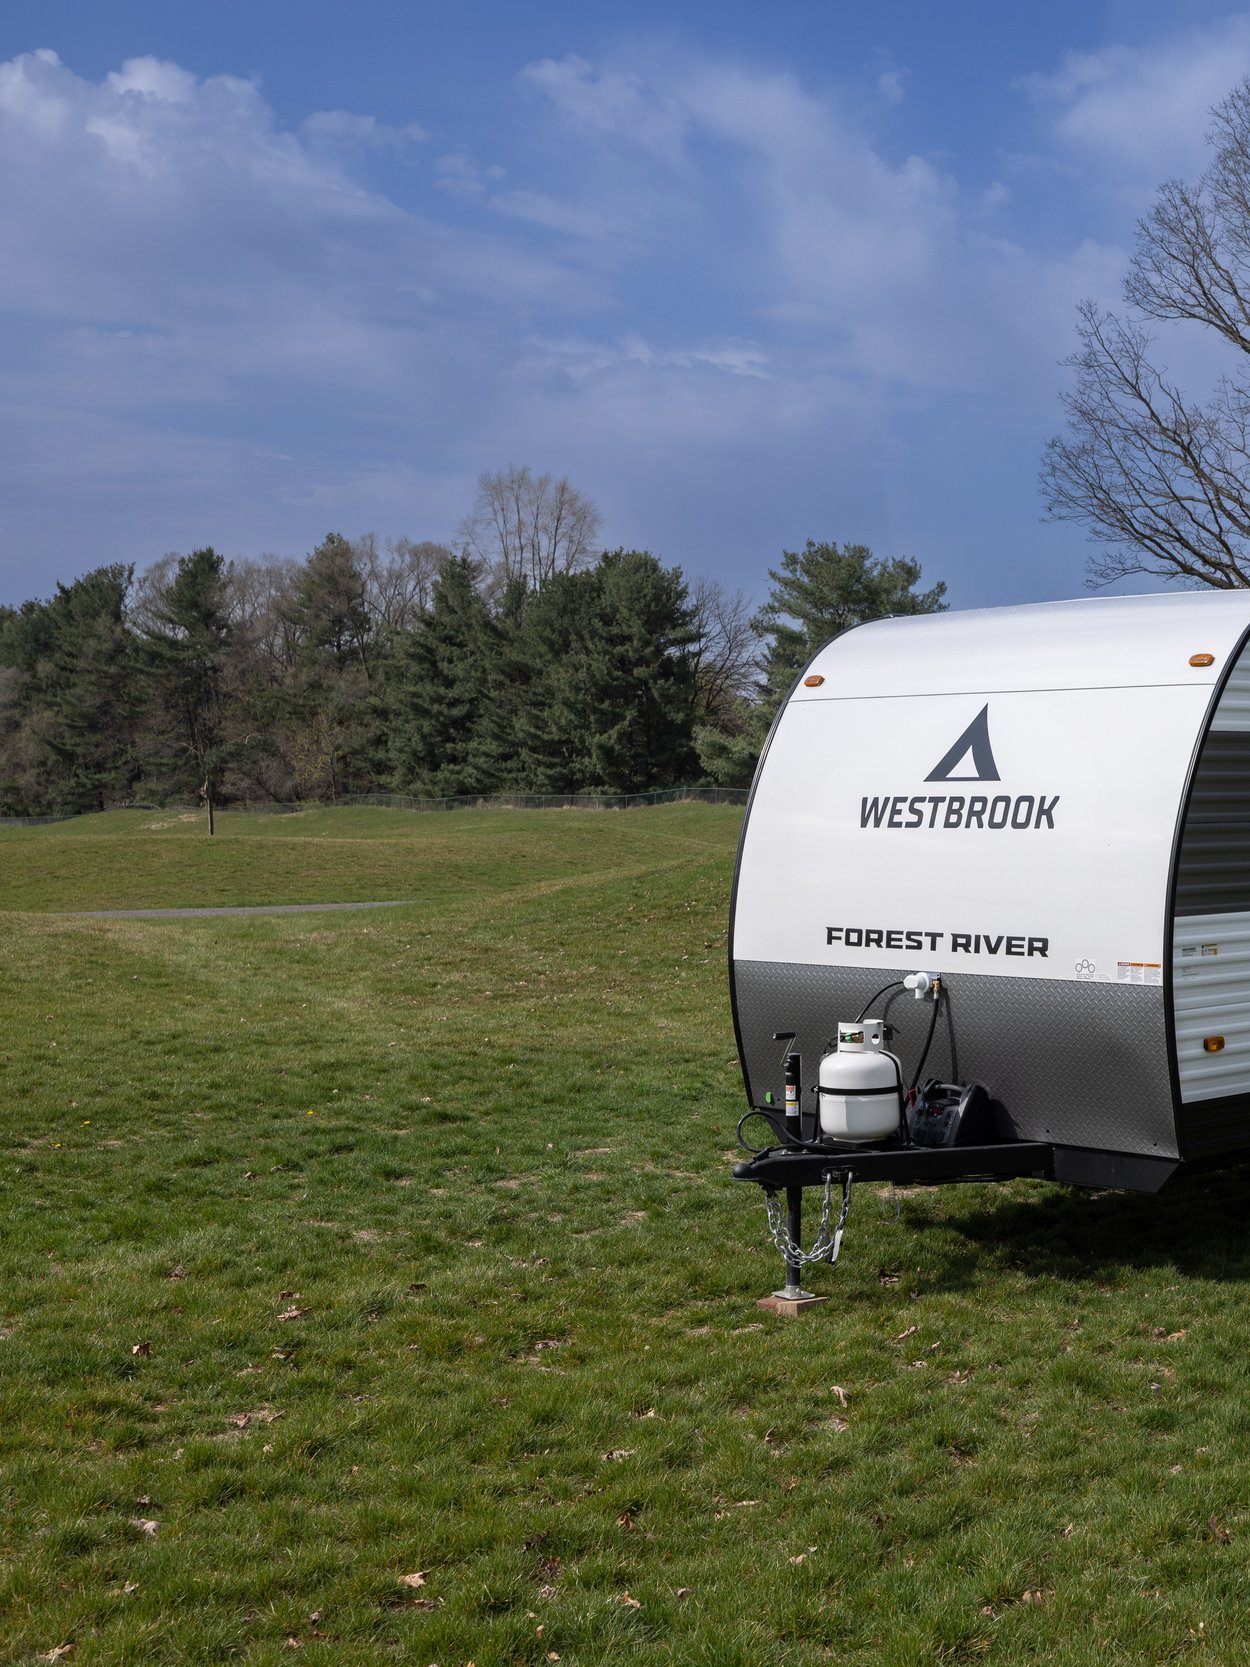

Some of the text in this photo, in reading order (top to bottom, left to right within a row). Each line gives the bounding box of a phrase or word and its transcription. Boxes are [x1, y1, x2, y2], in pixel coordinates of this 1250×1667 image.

[861, 796, 1060, 829] WESTBROOK
[826, 927, 1048, 957] FOREST RIVER
